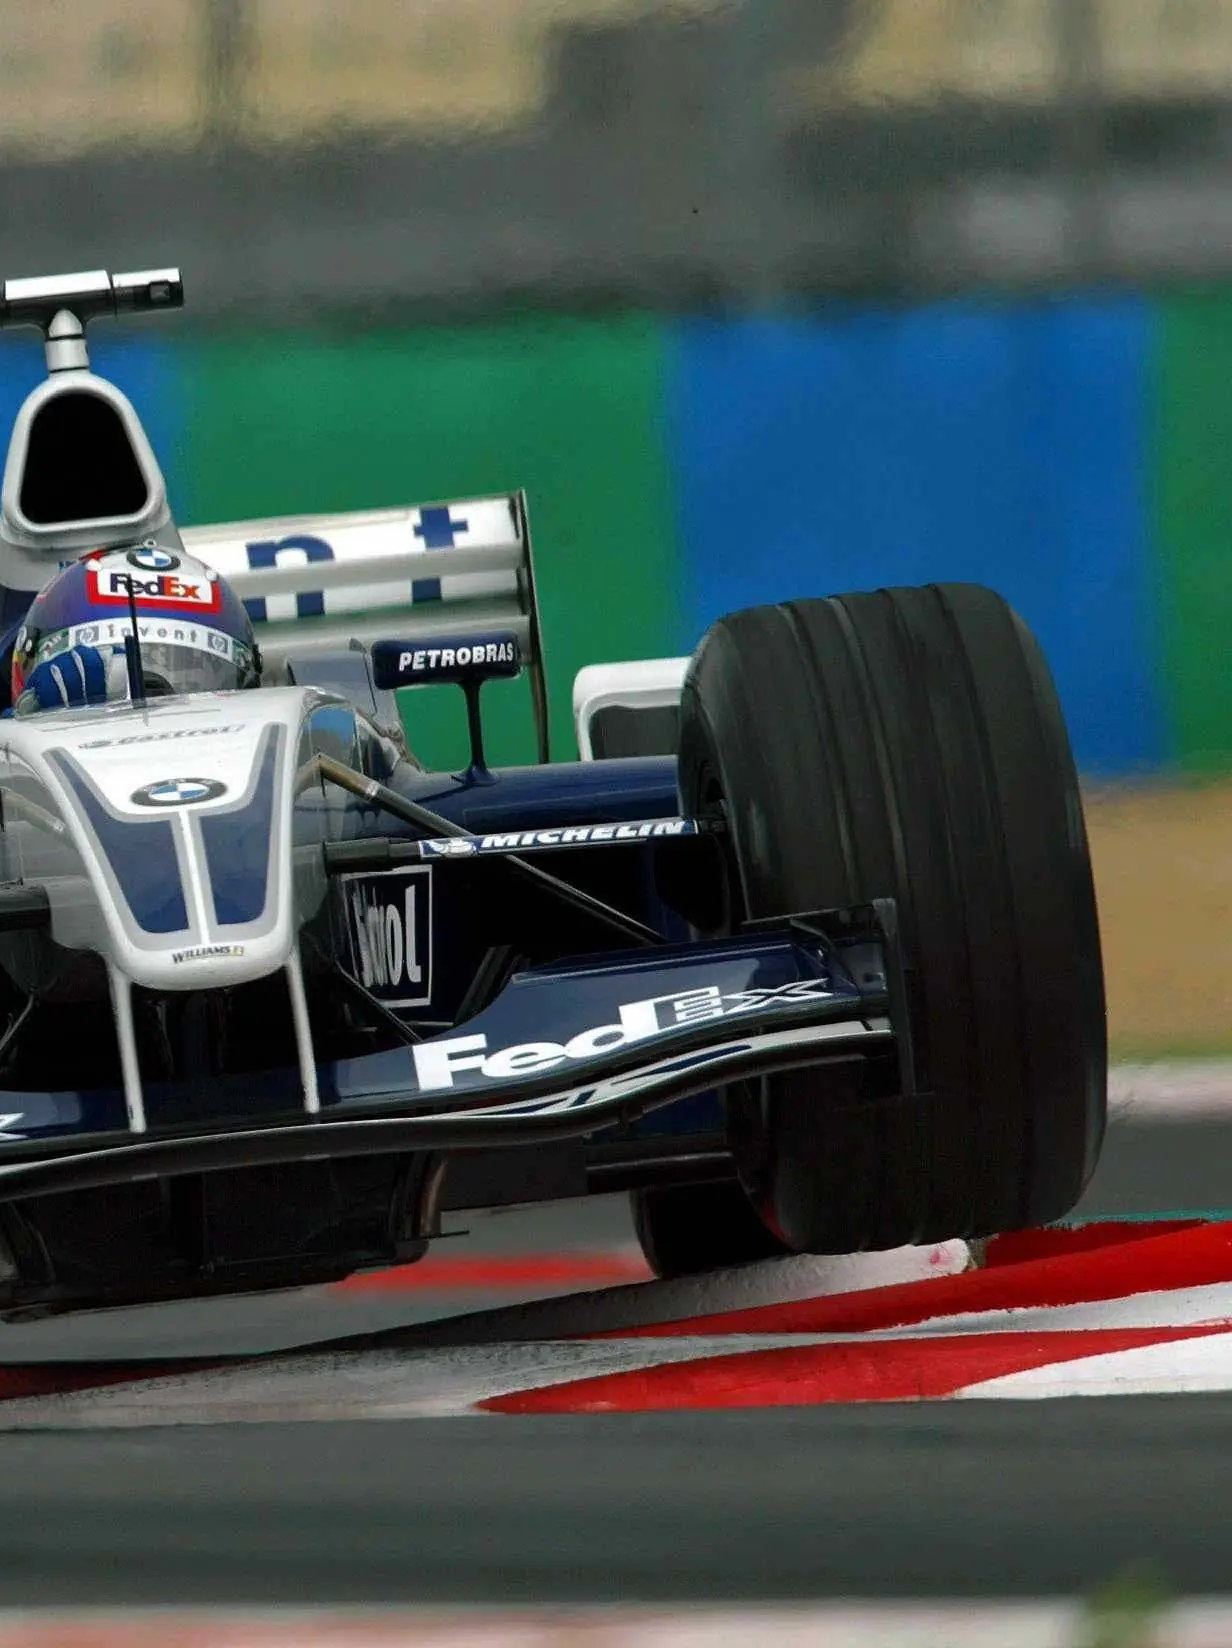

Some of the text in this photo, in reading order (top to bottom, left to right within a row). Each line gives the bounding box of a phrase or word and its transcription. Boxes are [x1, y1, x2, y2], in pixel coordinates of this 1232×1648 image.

[109, 572, 202, 600] FedEx
[107, 625, 198, 643] invent
[398, 642, 516, 672] PETROBRAS
[480, 820, 687, 849] MICHELIN
[412, 978, 834, 1091] FedEx
